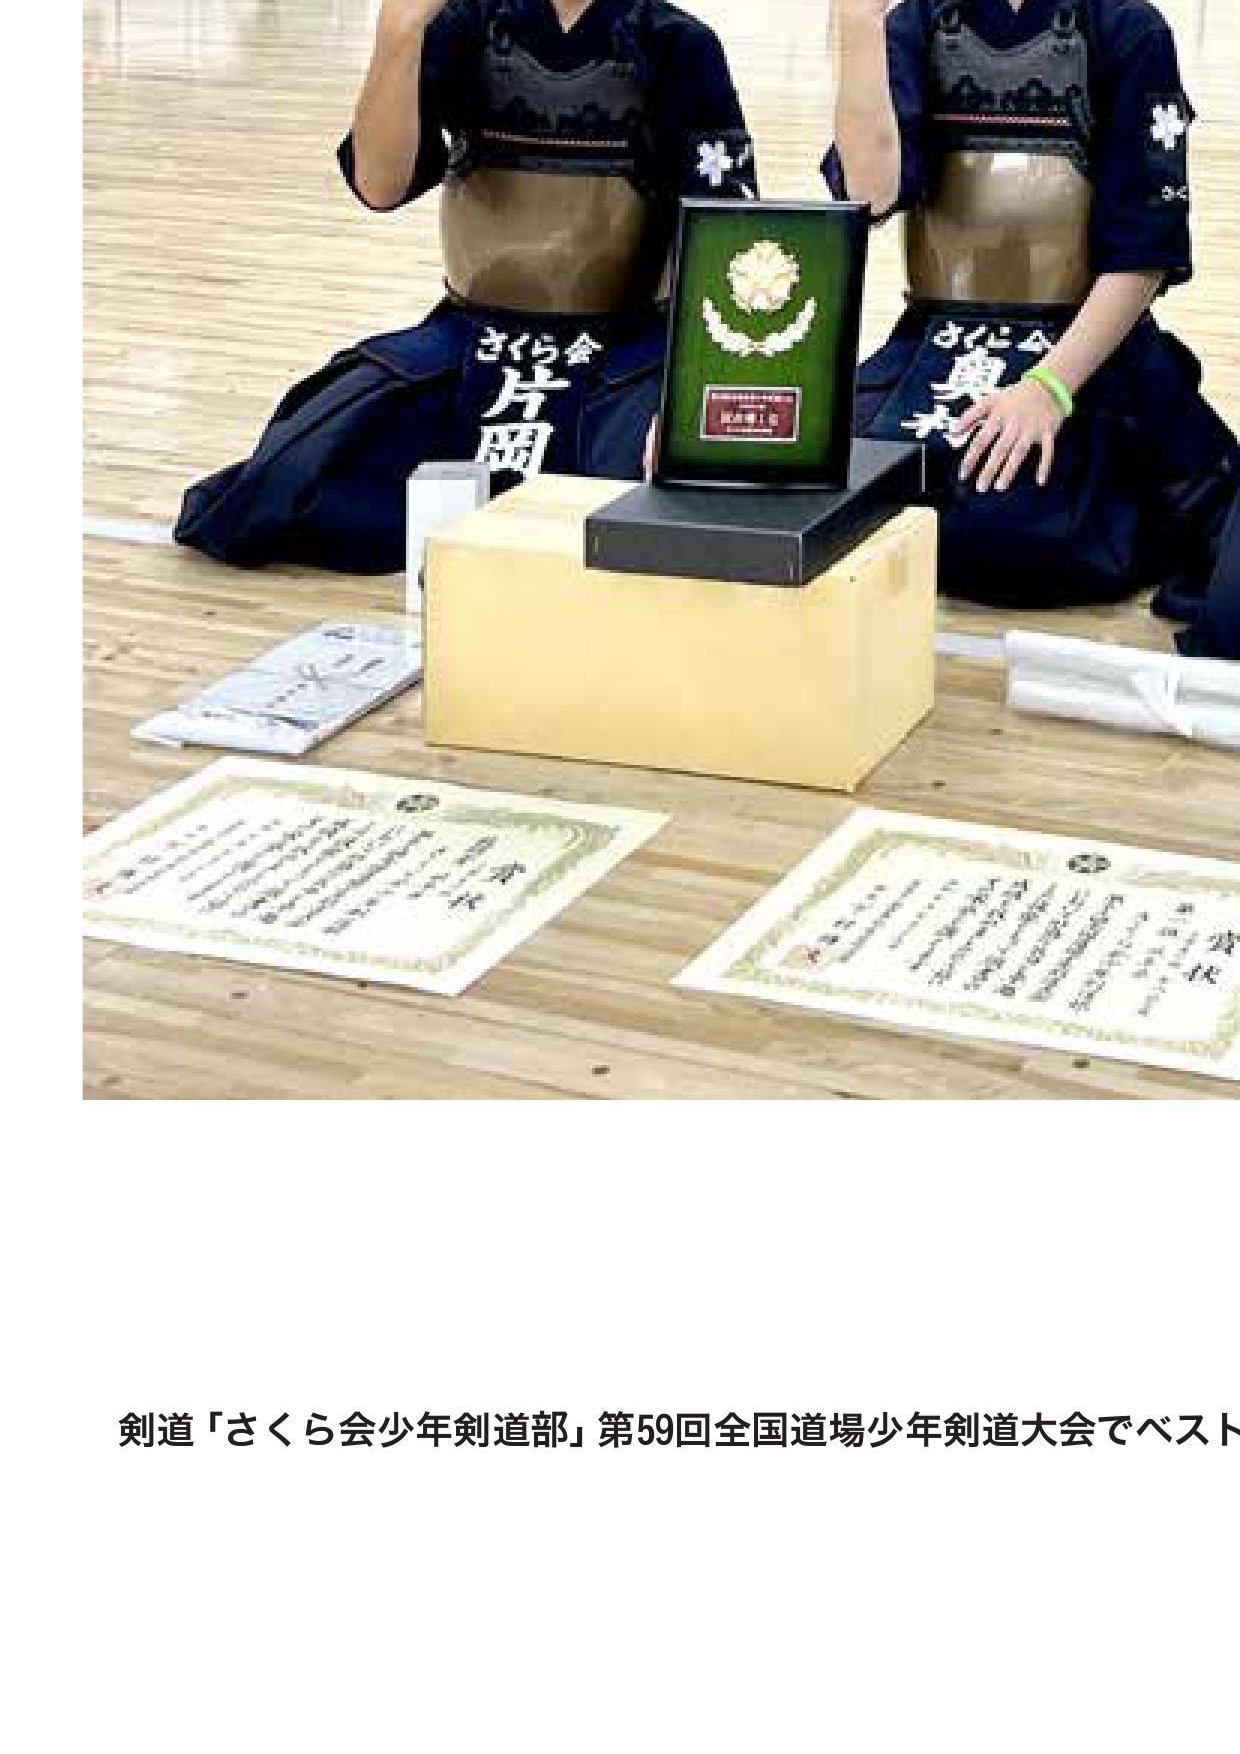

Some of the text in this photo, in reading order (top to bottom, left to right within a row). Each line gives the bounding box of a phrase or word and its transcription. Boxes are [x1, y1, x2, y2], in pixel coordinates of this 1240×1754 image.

[476, 326, 604, 367] さくら会
[476, 364, 571, 480] 片岡
